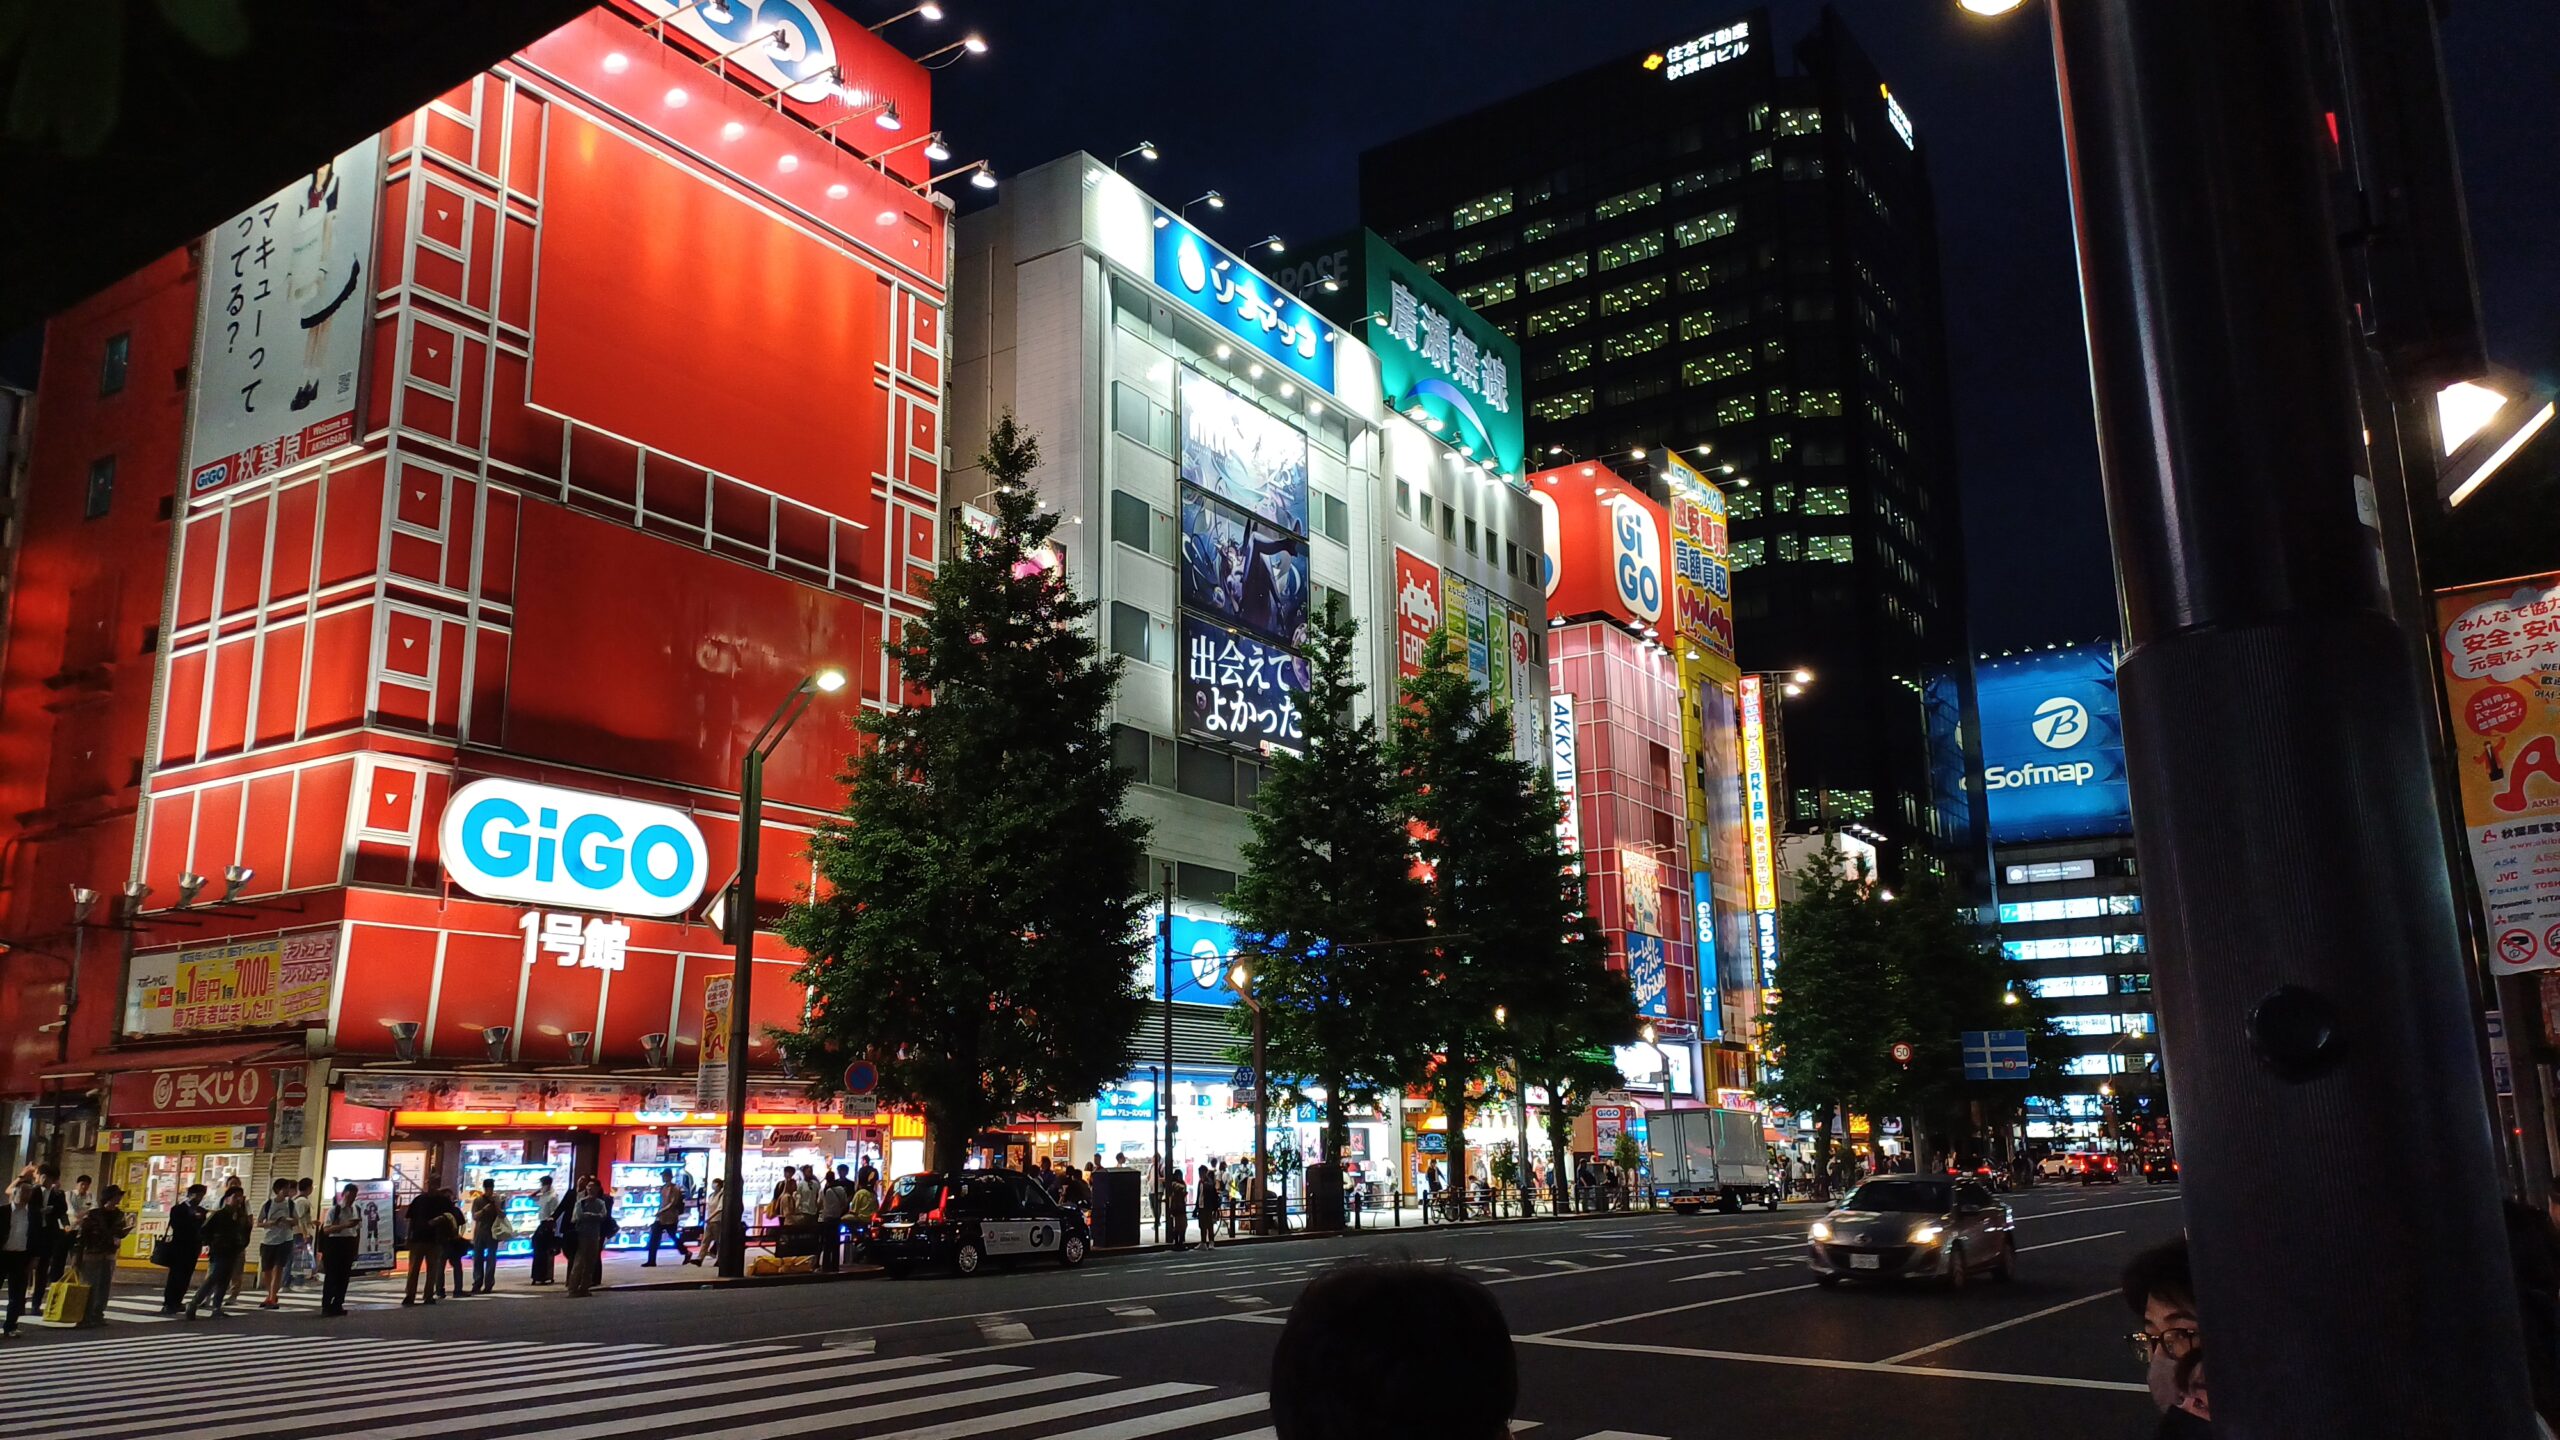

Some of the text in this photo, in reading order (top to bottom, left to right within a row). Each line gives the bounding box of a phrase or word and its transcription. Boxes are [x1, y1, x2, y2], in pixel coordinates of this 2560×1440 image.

[1666, 22, 1749, 63] 住友不動産
[1666, 41, 1749, 81] 秋葉原ビル
[236, 435, 302, 483] 秋葉原
[1616, 503, 1642, 558] Gi
[1618, 552, 1658, 612] GO
[1676, 541, 1728, 597] 高額買取
[1190, 635, 1292, 691] 出会えて
[1206, 688, 1302, 738] よかった
[1553, 701, 1573, 766] AKKY
[1750, 772, 1764, 820] AKIBA
[1984, 761, 2094, 790] Sofmap
[461, 797, 694, 898] GiGO
[2496, 871, 2518, 883] JVC
[519, 911, 631, 971] 1号館
[1697, 902, 1713, 943] GiGO
[283, 938, 333, 959] ギフトカード
[173, 1000, 273, 1027] 億万長者出ました!!
[1896, 1047, 1908, 1058] 50
[176, 1070, 234, 1108] 宝くじ
[1236, 1072, 1253, 1081] 437
[1597, 1108, 1620, 1118] GiGO
[1029, 1225, 1055, 1248] GO
